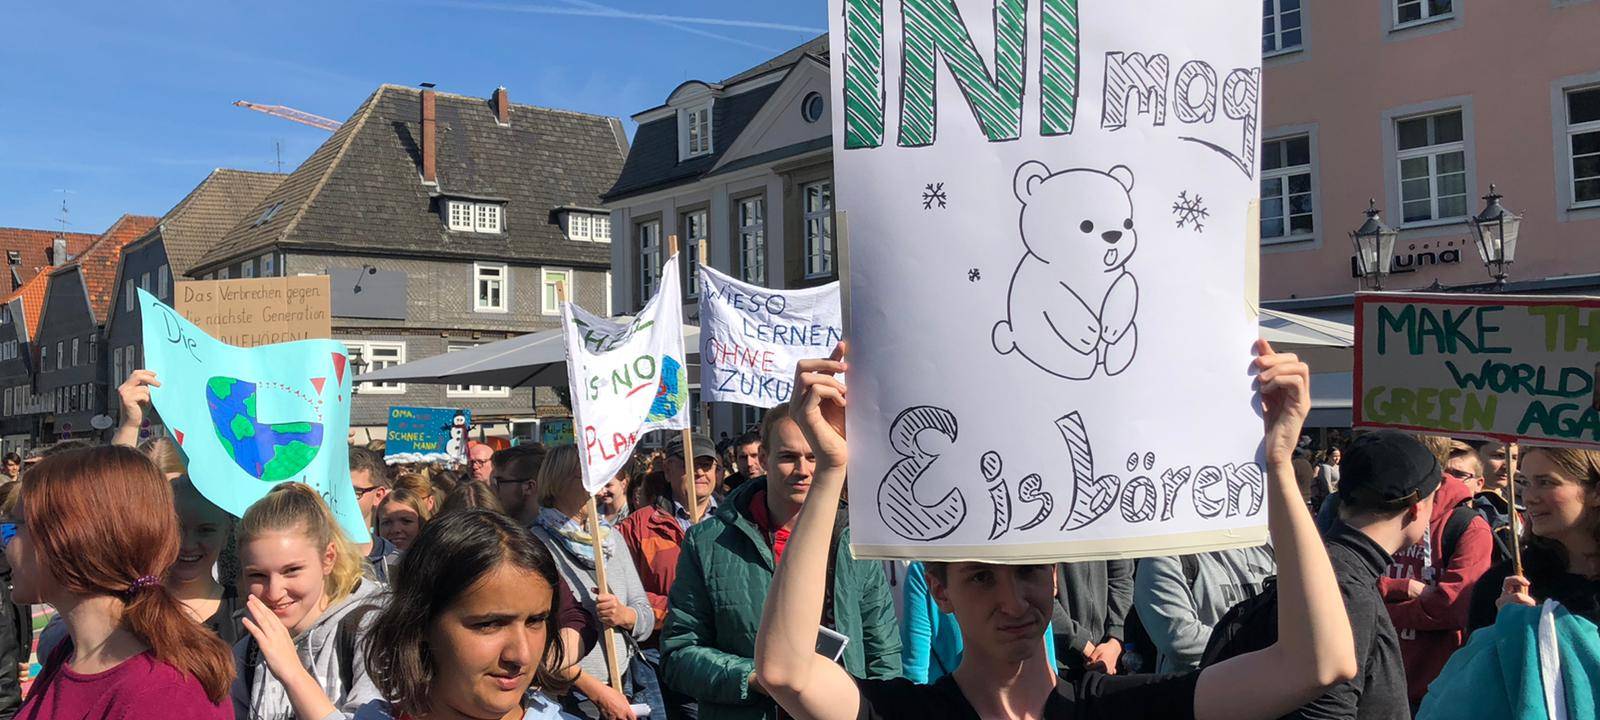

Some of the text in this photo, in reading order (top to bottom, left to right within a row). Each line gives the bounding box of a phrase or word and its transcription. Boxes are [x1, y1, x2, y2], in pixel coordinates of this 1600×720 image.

[842, 0, 1260, 180] INI mag
[1408, 239, 1466, 251] Gelat
[184, 285, 321, 305] Das Verbrechen gegen
[262, 305, 325, 323] Generation
[153, 302, 202, 363] Die
[743, 318, 842, 347] LERNEN
[1377, 303, 1600, 356] MAKE TH
[612, 354, 656, 395] NO
[705, 337, 775, 372] OHNE
[718, 368, 794, 402] ZUKU
[1445, 358, 1594, 398] WORLD
[1364, 385, 1600, 441] GREEN AGA
[877, 404, 1264, 541] Eisbären
